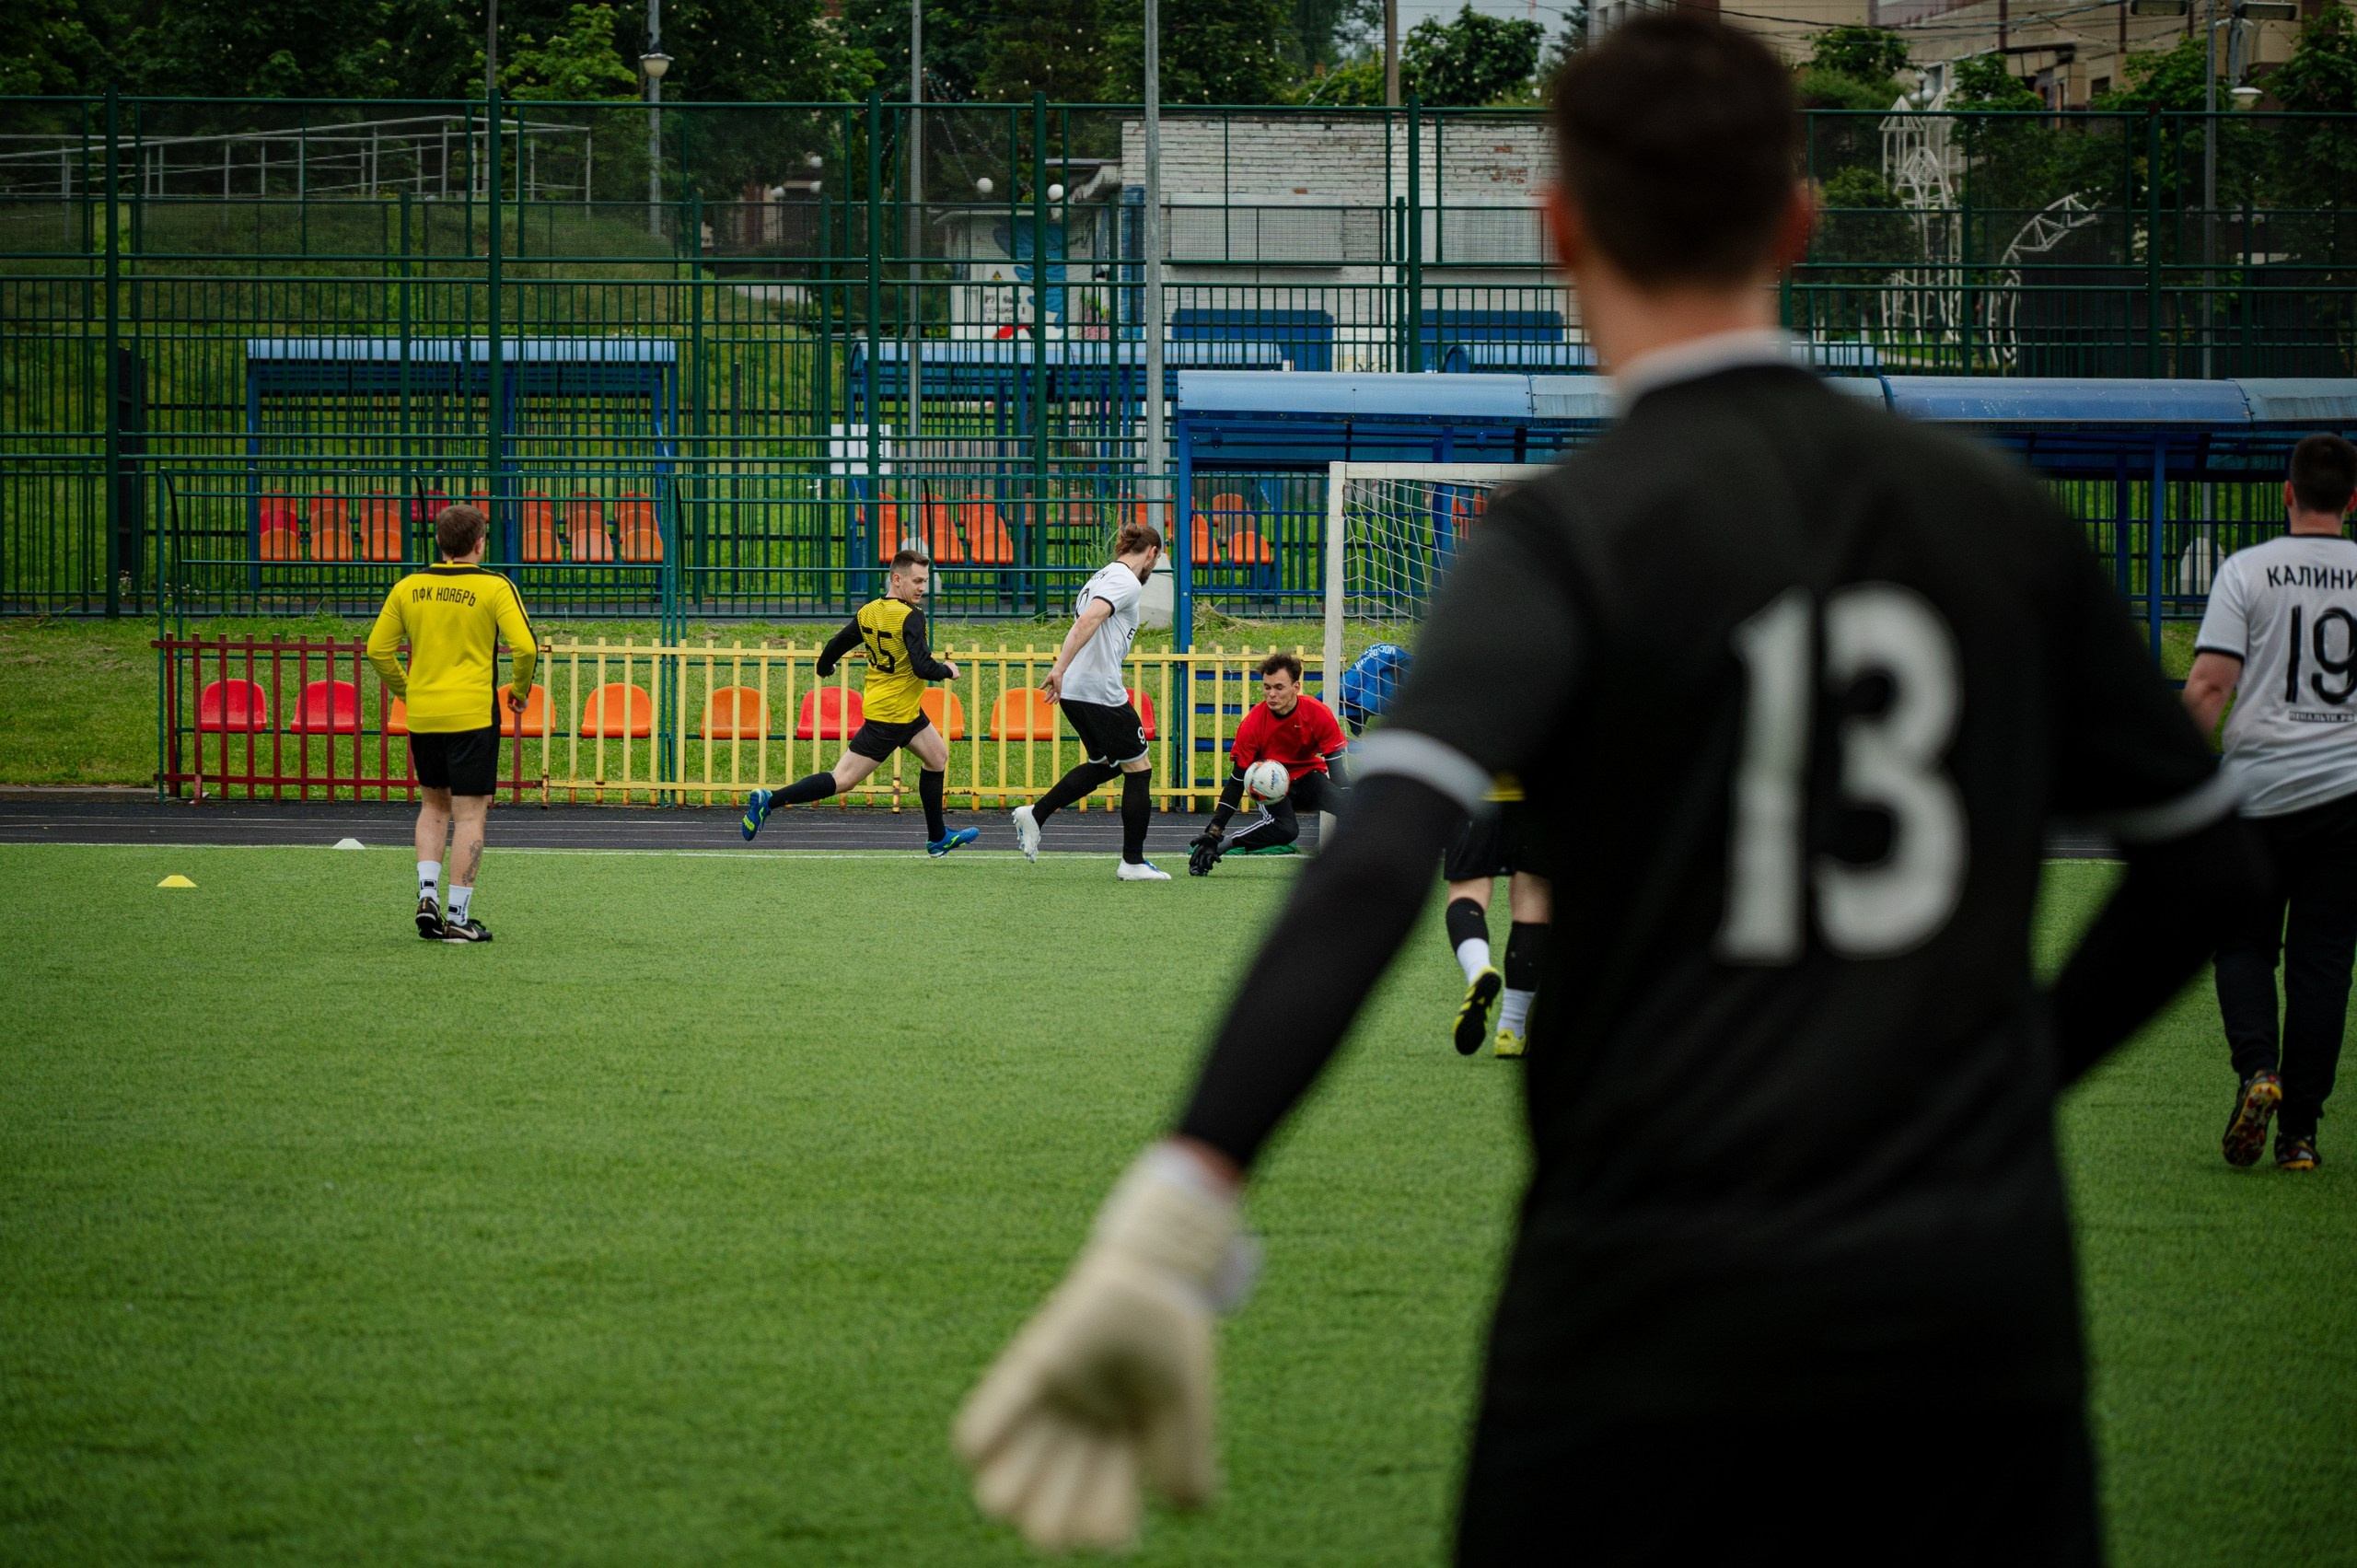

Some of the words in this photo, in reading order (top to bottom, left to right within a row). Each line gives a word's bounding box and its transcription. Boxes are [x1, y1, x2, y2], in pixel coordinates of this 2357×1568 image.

[436, 587, 476, 607] НОЯБРЬ
[2284, 604, 2357, 705] 19
[1714, 582, 1968, 963] 13
